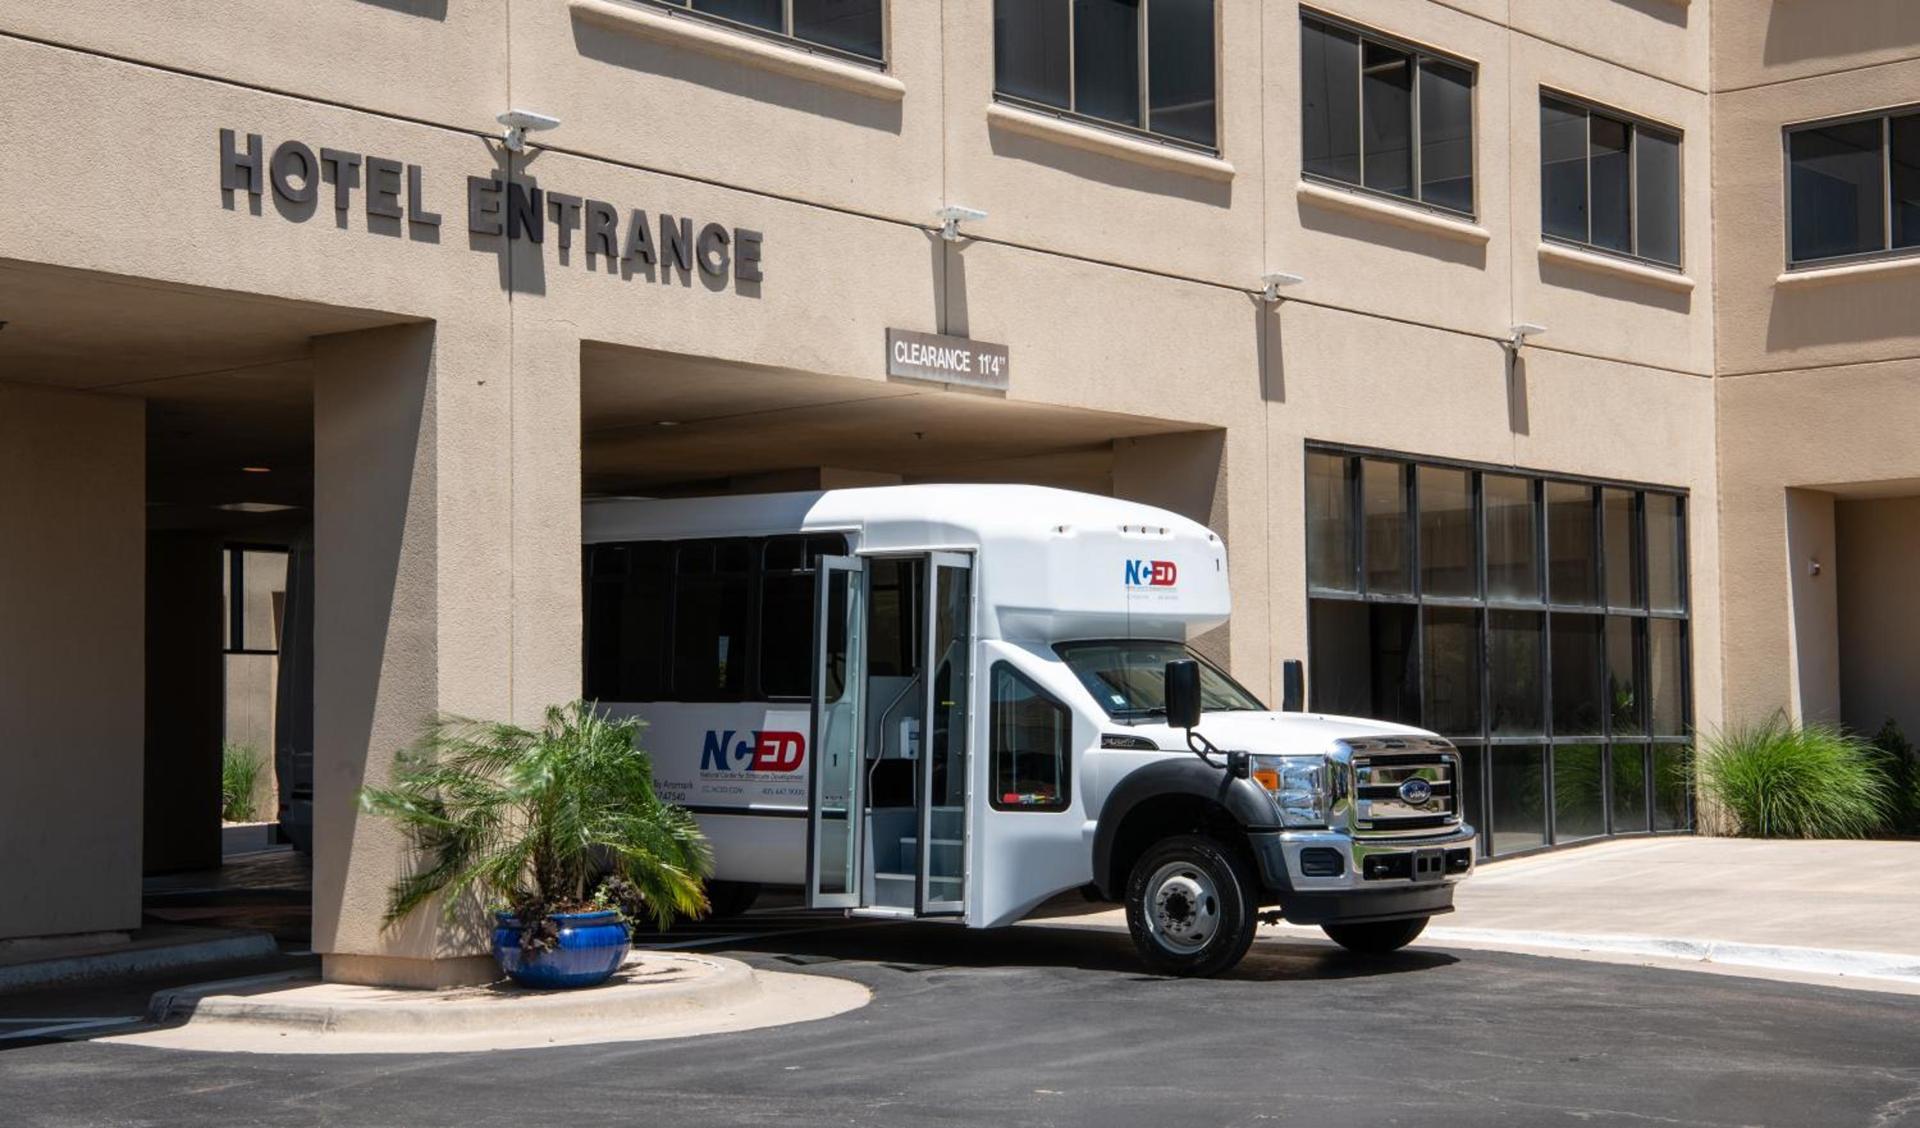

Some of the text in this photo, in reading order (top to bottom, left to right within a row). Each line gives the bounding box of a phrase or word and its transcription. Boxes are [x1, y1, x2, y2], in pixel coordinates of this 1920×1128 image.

[219, 127, 764, 283] HOTEL ENTRANCE
[894, 340, 1006, 377] CLEARANCE 11'4"
[1125, 559, 1177, 587] NCED
[700, 730, 806, 773] NCED
[832, 753, 838, 767] 1
